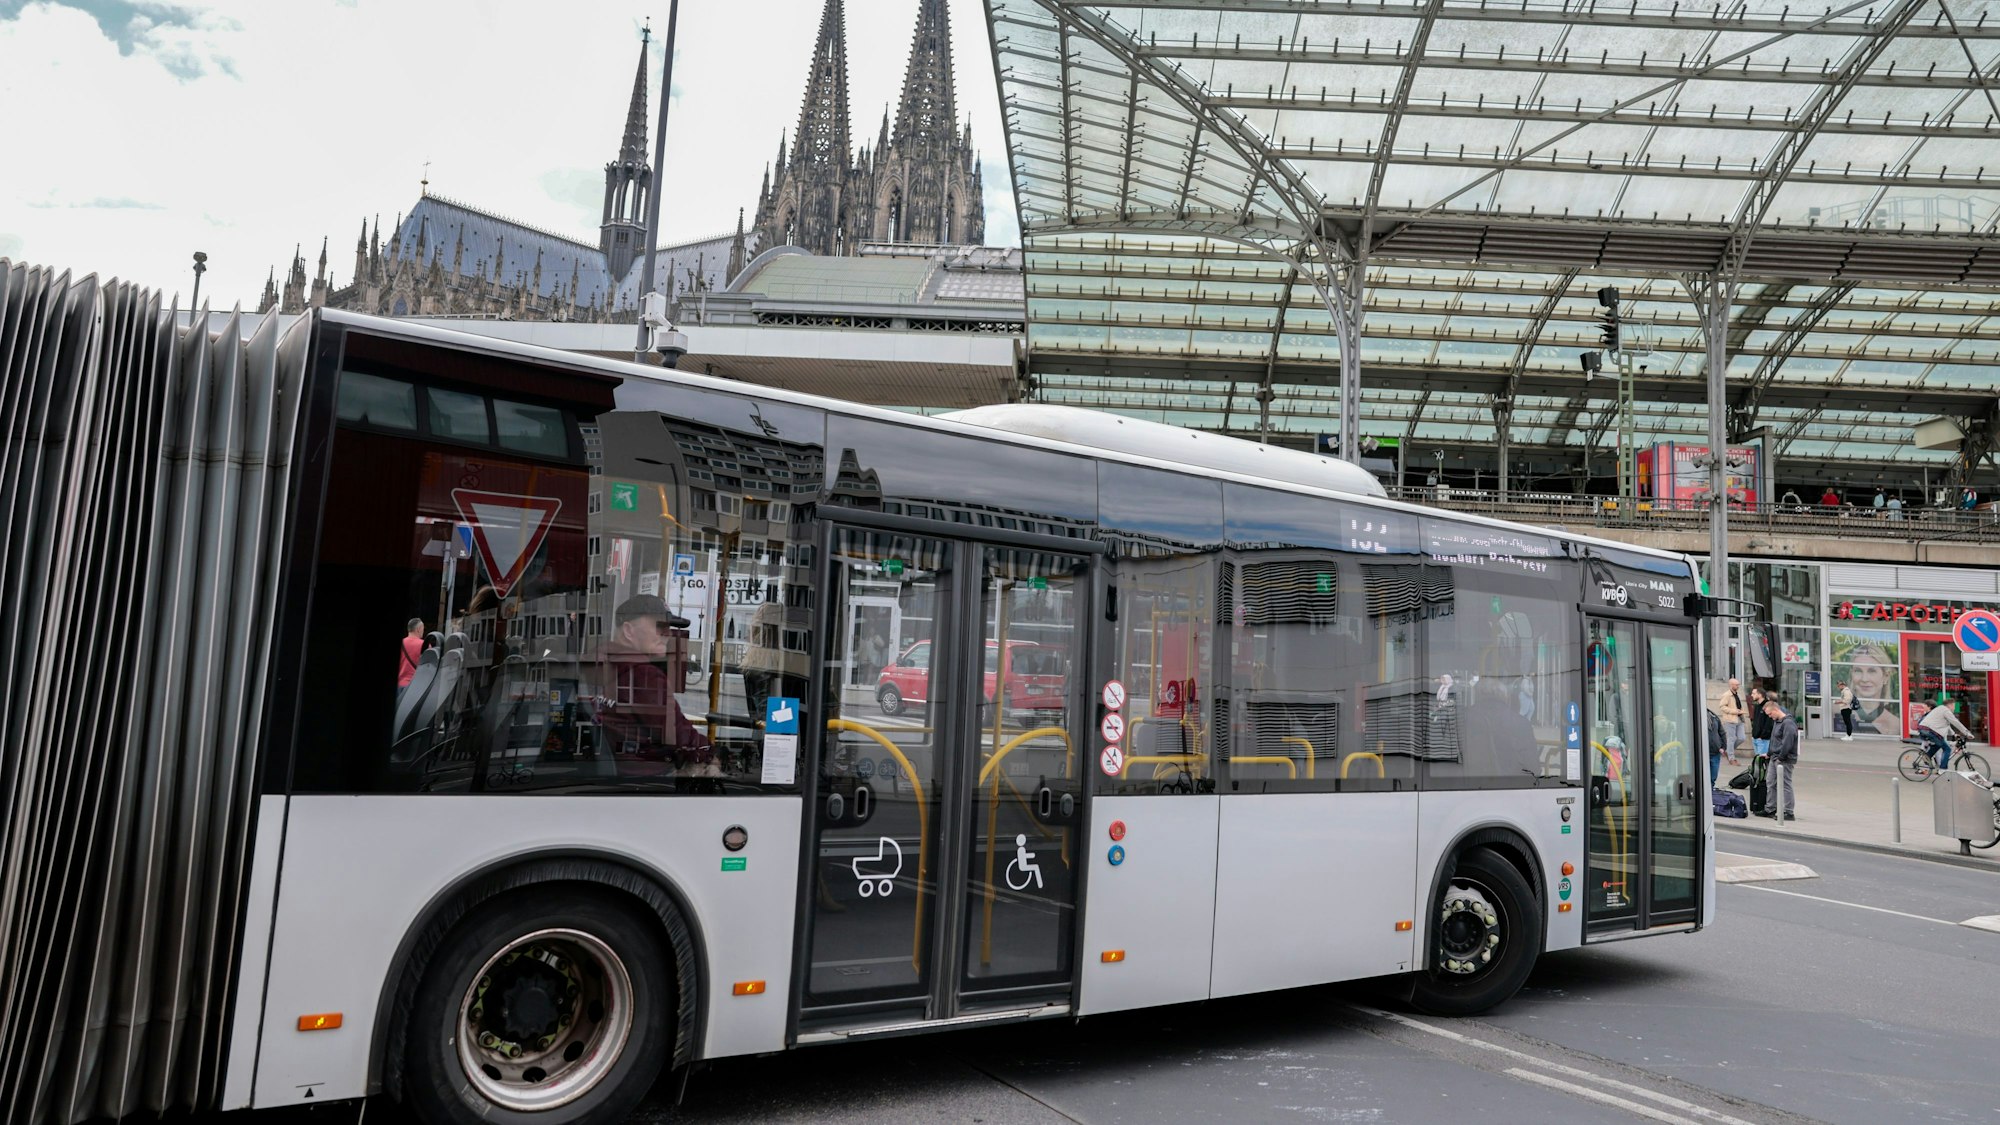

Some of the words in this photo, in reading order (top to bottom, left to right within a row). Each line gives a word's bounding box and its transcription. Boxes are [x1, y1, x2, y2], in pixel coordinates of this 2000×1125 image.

[1649, 580, 1674, 593] MAN
[1601, 588, 1617, 601] KVB
[1658, 595, 1675, 608] 5022
[1558, 881, 1569, 891] VRS
